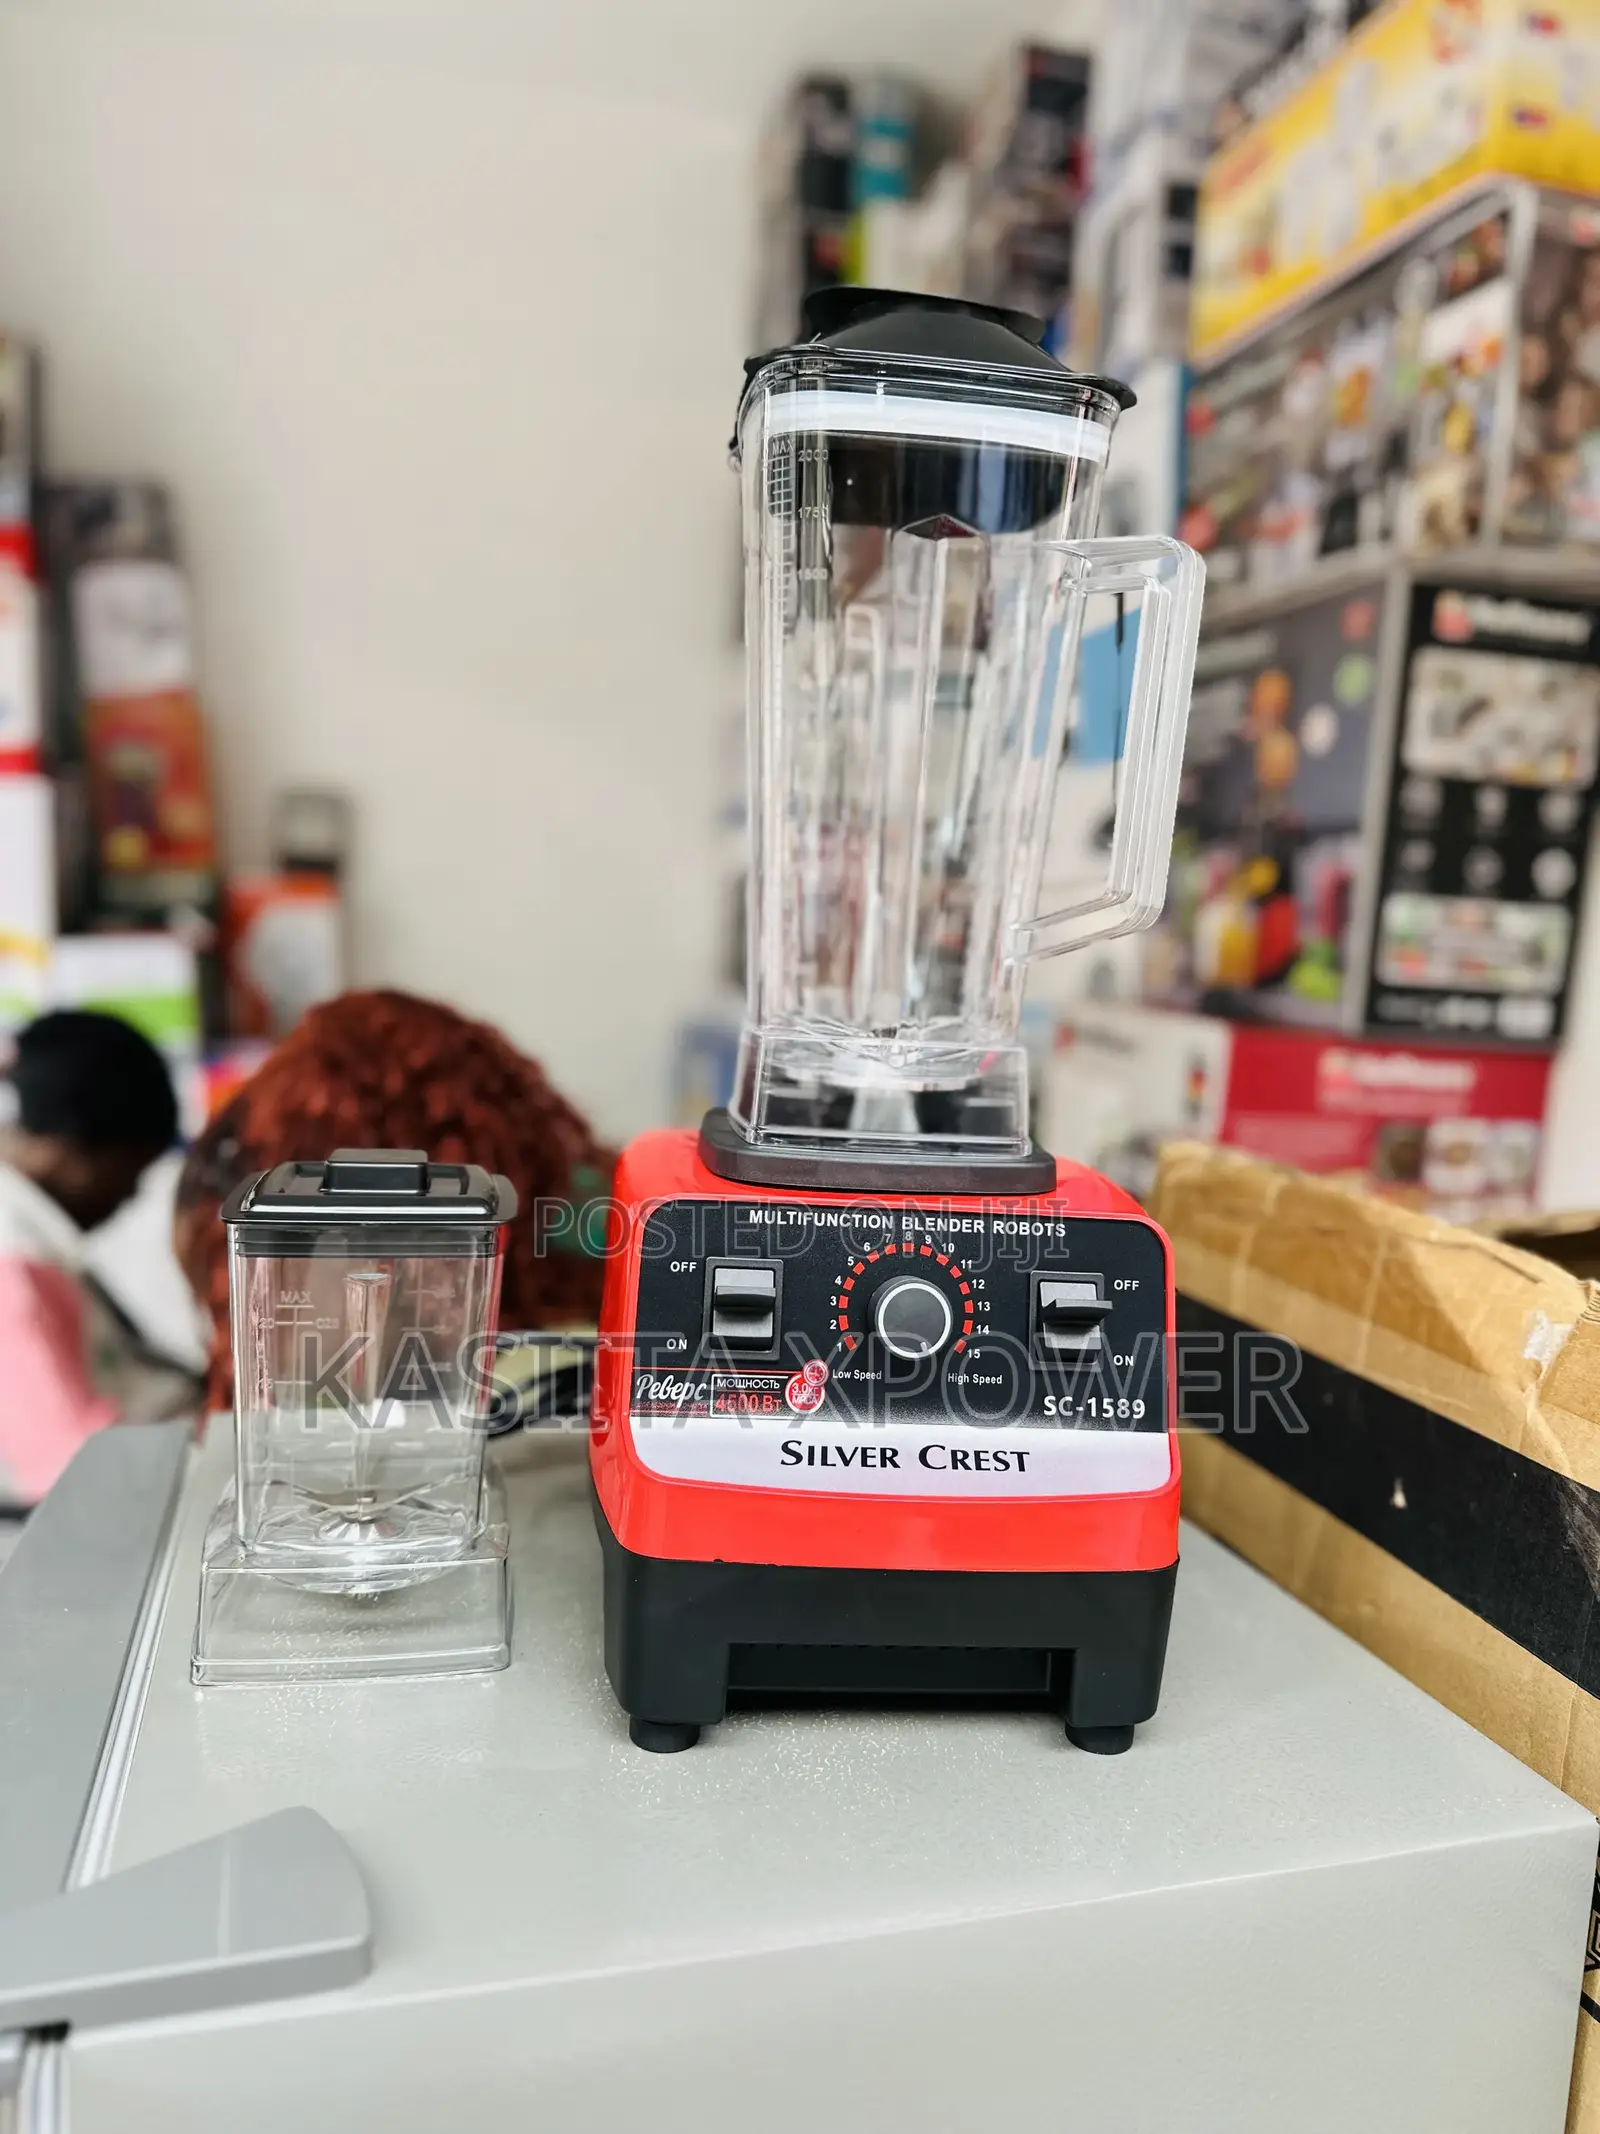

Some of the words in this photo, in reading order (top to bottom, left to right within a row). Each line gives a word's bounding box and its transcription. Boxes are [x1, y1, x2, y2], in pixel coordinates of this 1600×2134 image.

[798, 449, 829, 462] 2000
[798, 507, 829, 519] 1750
[749, 1209, 895, 1230] MULTIFUNCTION
[901, 1216, 985, 1233] BLENDER
[992, 1220, 1066, 1237] ROBOTS
[884, 1233, 892, 1243] 7
[904, 1231, 913, 1241] 8
[924, 1234, 932, 1244] 9
[863, 1242, 871, 1251] 6
[942, 1243, 955, 1253] 10
[670, 1261, 697, 1273] OFF
[847, 1256, 854, 1267] 5
[960, 1259, 973, 1270] 11
[834, 1275, 842, 1285] 4
[971, 1279, 985, 1289] 12
[1113, 1279, 1140, 1291] OFF
[280, 1290, 313, 1303] MAX
[829, 1295, 837, 1306] 3
[977, 1301, 991, 1312] 13
[829, 1320, 837, 1330] 2
[976, 1324, 990, 1335] 14
[666, 1338, 688, 1350] ON
[836, 1342, 843, 1352] 1
[967, 1348, 981, 1359] 15
[1113, 1354, 1134, 1367] ON
[832, 1369, 852, 1380] Low
[853, 1370, 883, 1382] Speed
[947, 1373, 970, 1385] High
[972, 1374, 1003, 1386] Speed
[716, 1378, 781, 1389] МОЩНОСТЬ
[636, 1374, 707, 1408] Реверс
[714, 1392, 759, 1413] 4500
[1043, 1395, 1146, 1420] SC-1589
[780, 1440, 902, 1468] SILVER
[918, 1444, 1030, 1473] CREST
